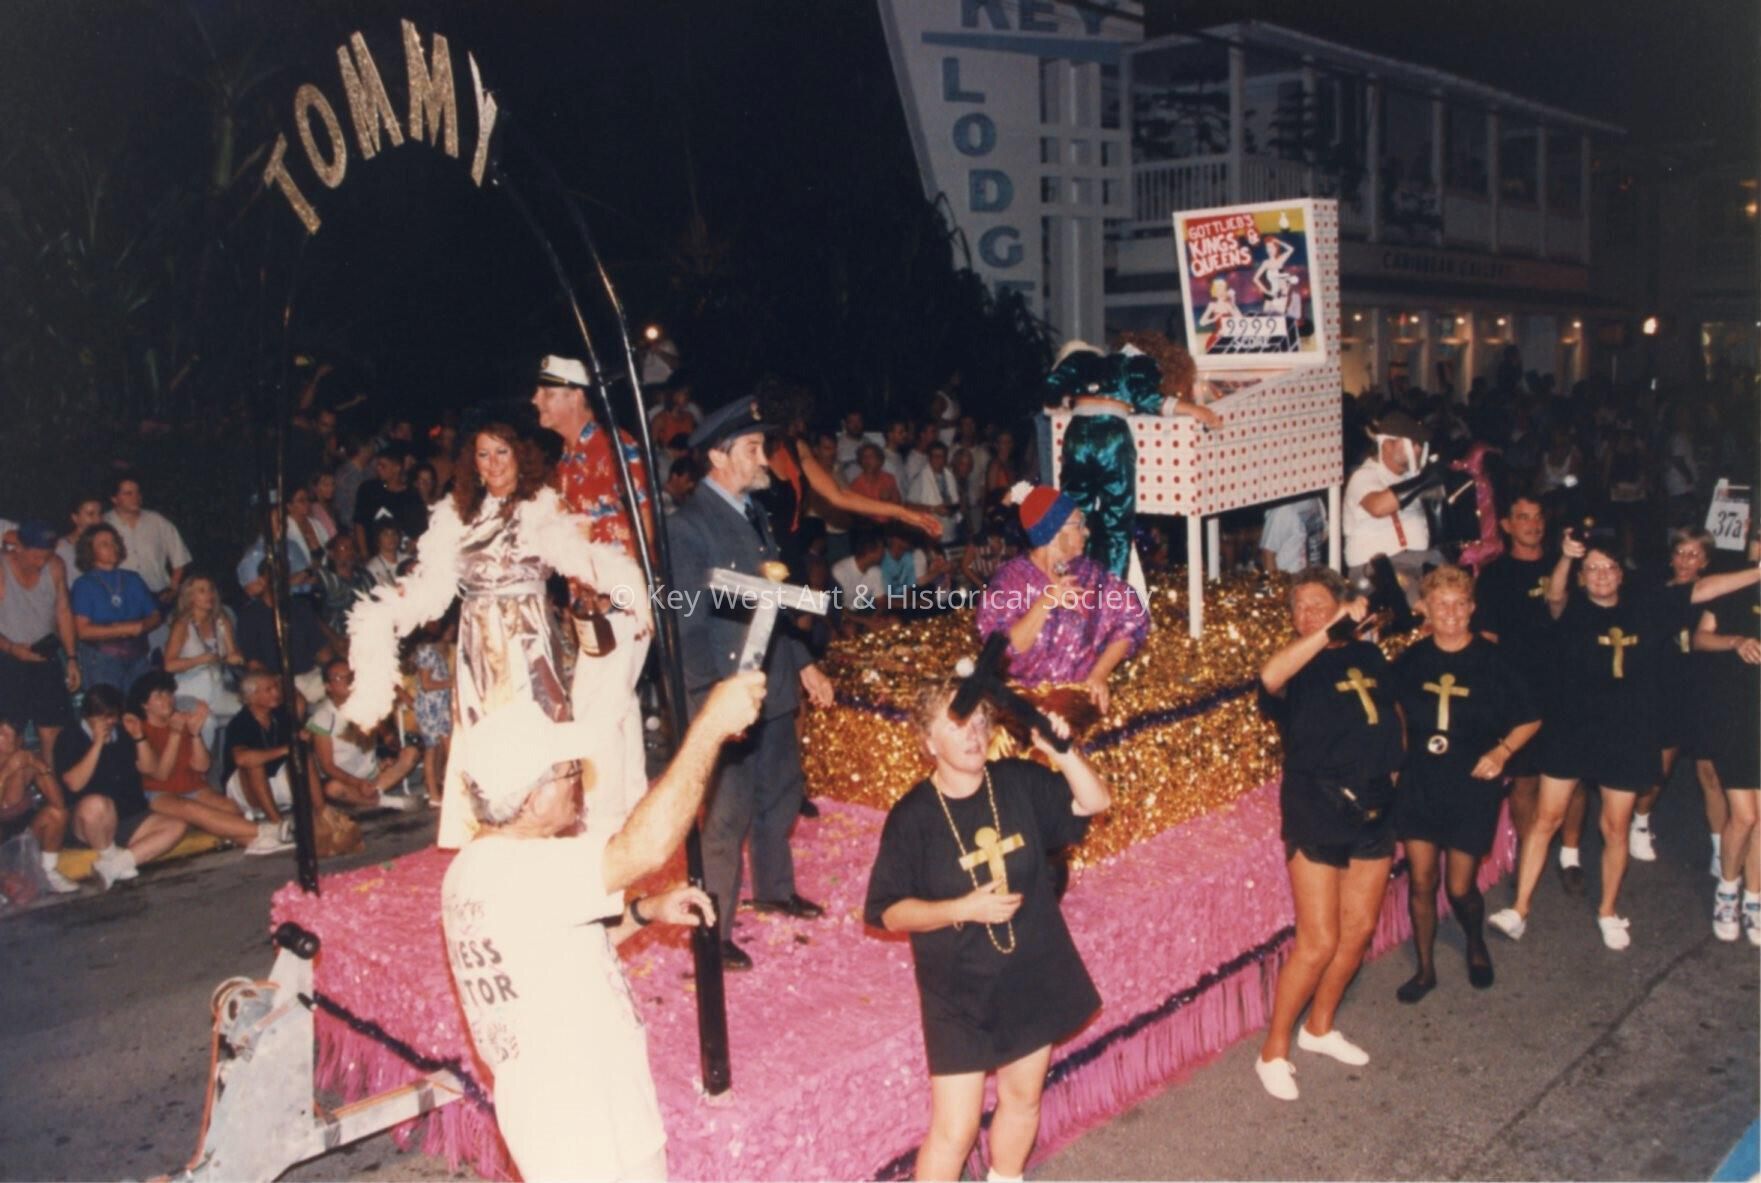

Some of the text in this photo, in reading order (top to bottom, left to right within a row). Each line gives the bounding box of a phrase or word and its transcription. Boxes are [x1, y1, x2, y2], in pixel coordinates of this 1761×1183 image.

[264, 18, 498, 235] TOMMY
[1188, 227, 1261, 257] KINGS &
[1191, 246, 1252, 278] QUEENS
[1713, 511, 1743, 539] 37a
[449, 937, 503, 970] ESS
